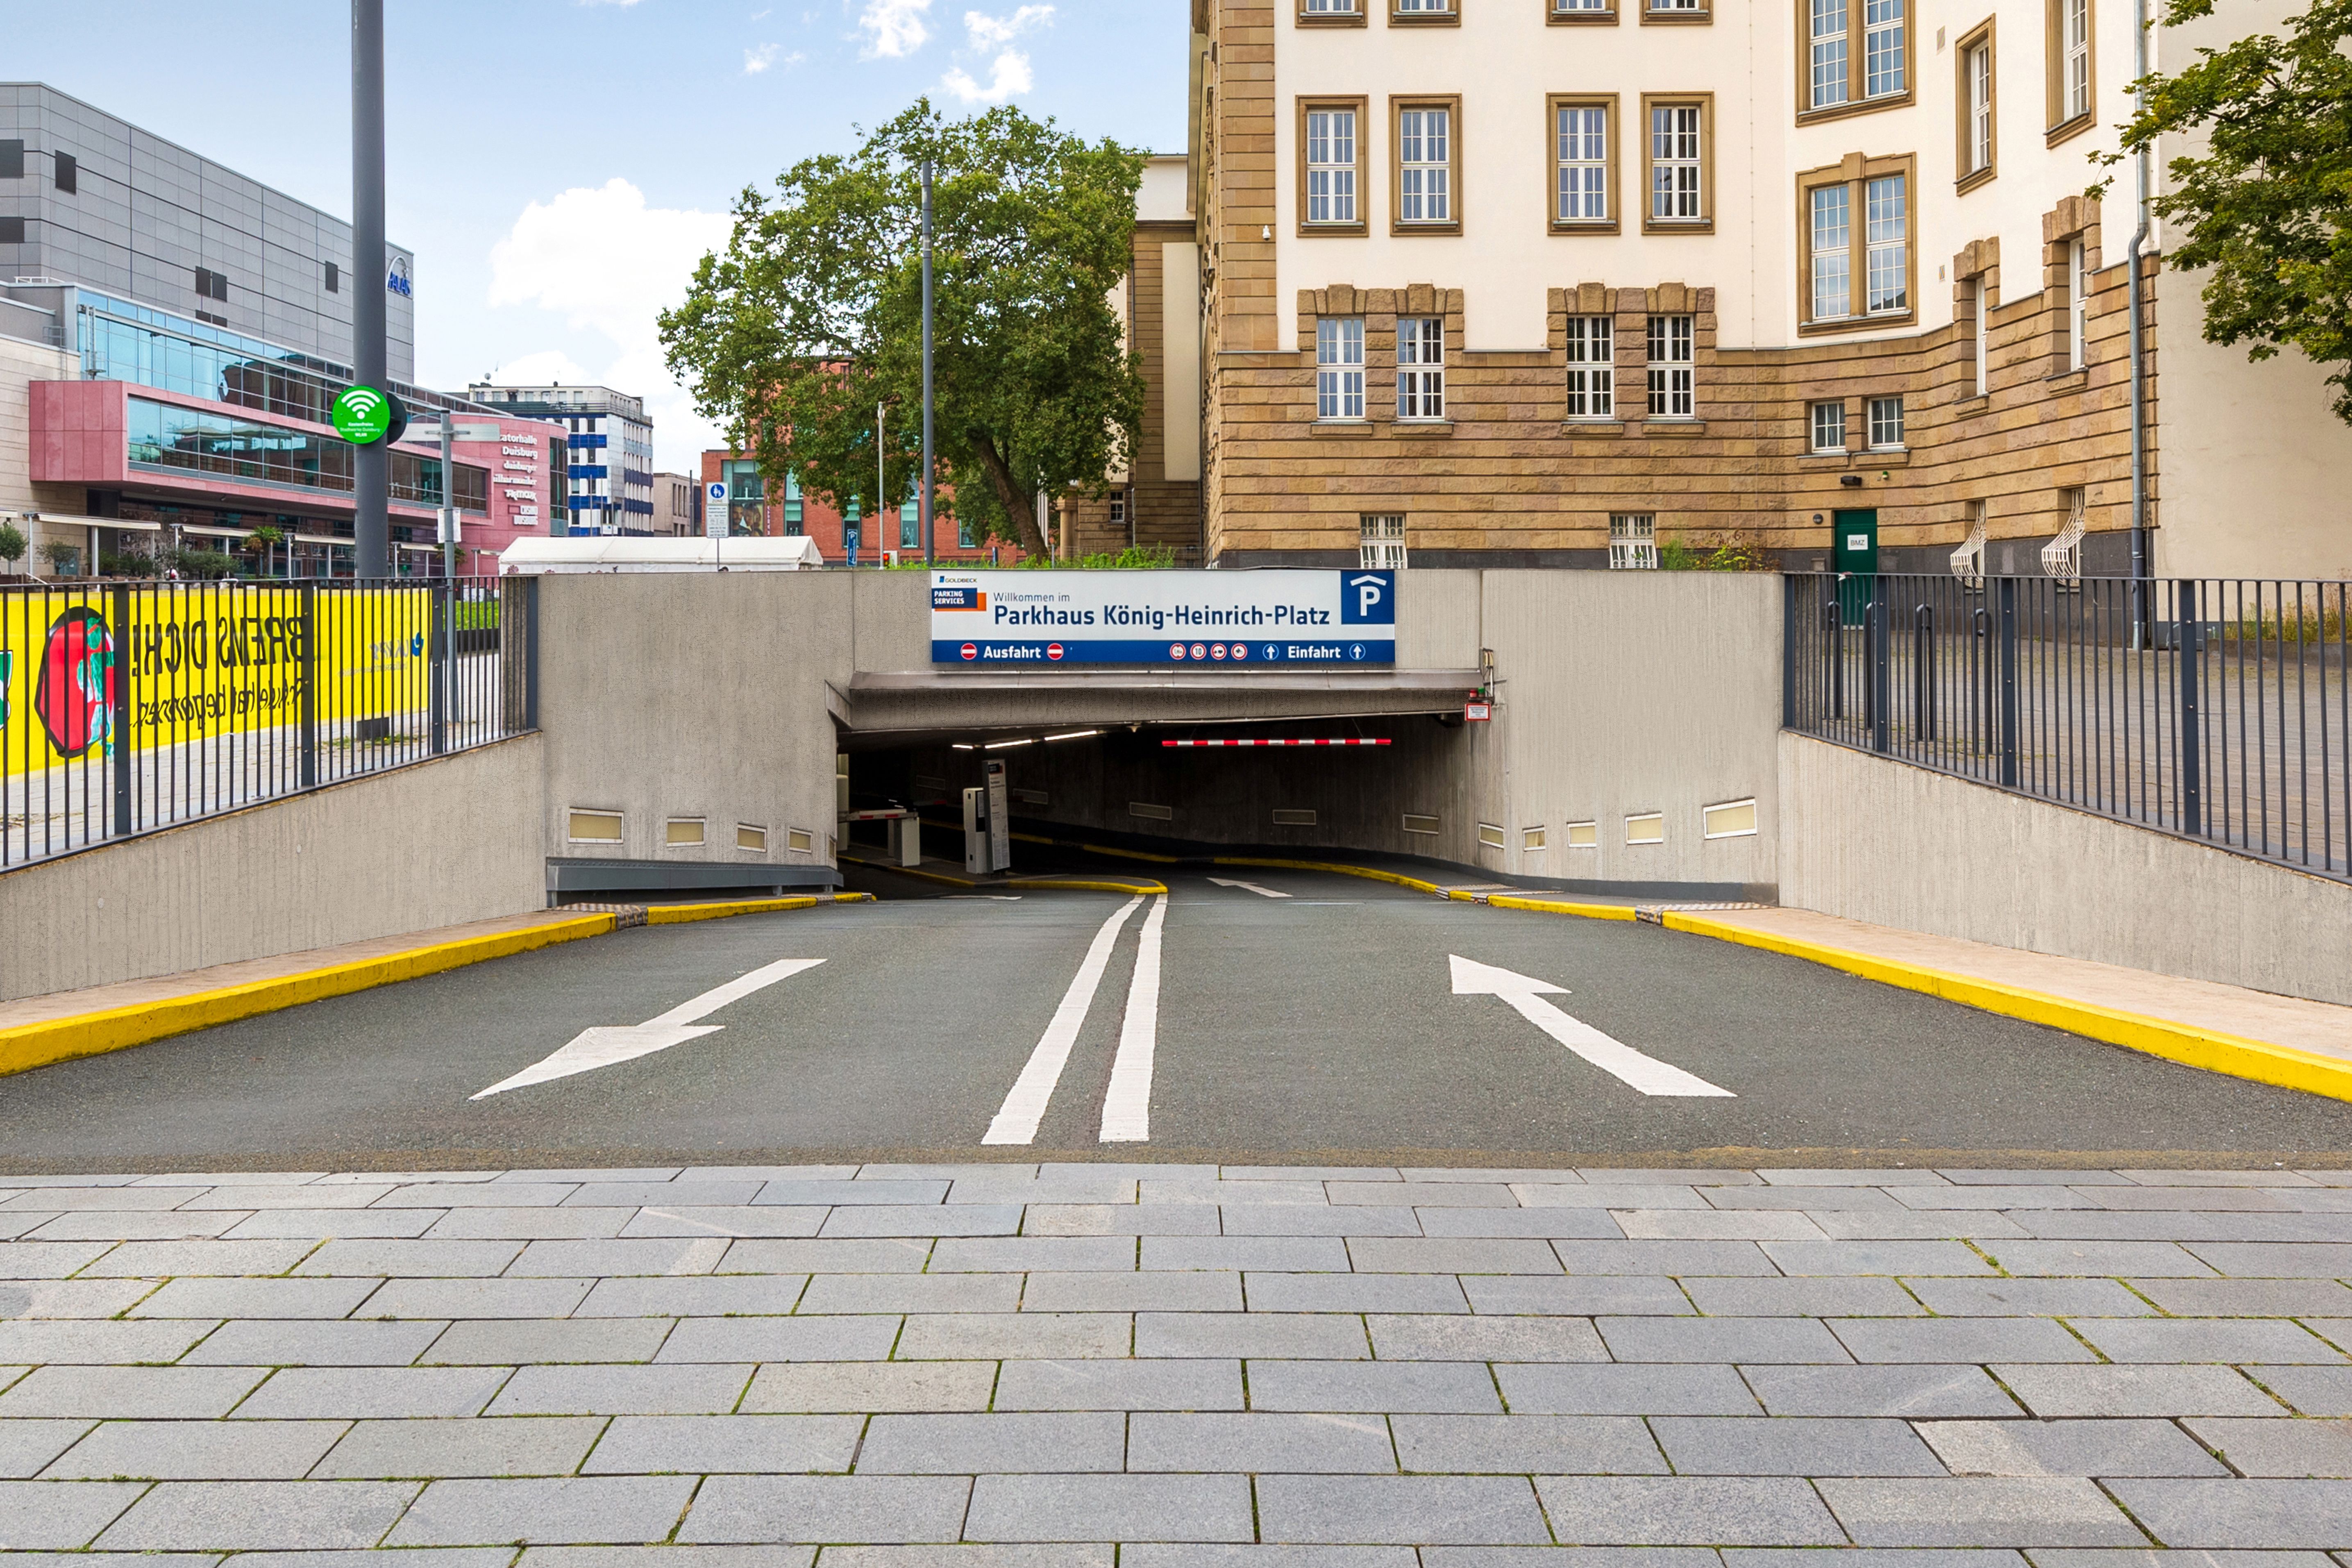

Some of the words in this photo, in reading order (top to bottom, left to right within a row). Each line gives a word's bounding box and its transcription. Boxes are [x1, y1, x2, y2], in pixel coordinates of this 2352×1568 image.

[500, 434, 538, 445] atorhalle
[502, 446, 538, 460] Duisburg
[993, 592, 1054, 602] Willkommen
[1058, 593, 1070, 602] im
[1360, 586, 1380, 616] P
[995, 605, 1094, 624] Parkhaus
[1104, 605, 1330, 630] König-Heinrich-Platz
[983, 646, 1041, 659] Ausfahrt
[1288, 646, 1341, 658] Einfahrt
